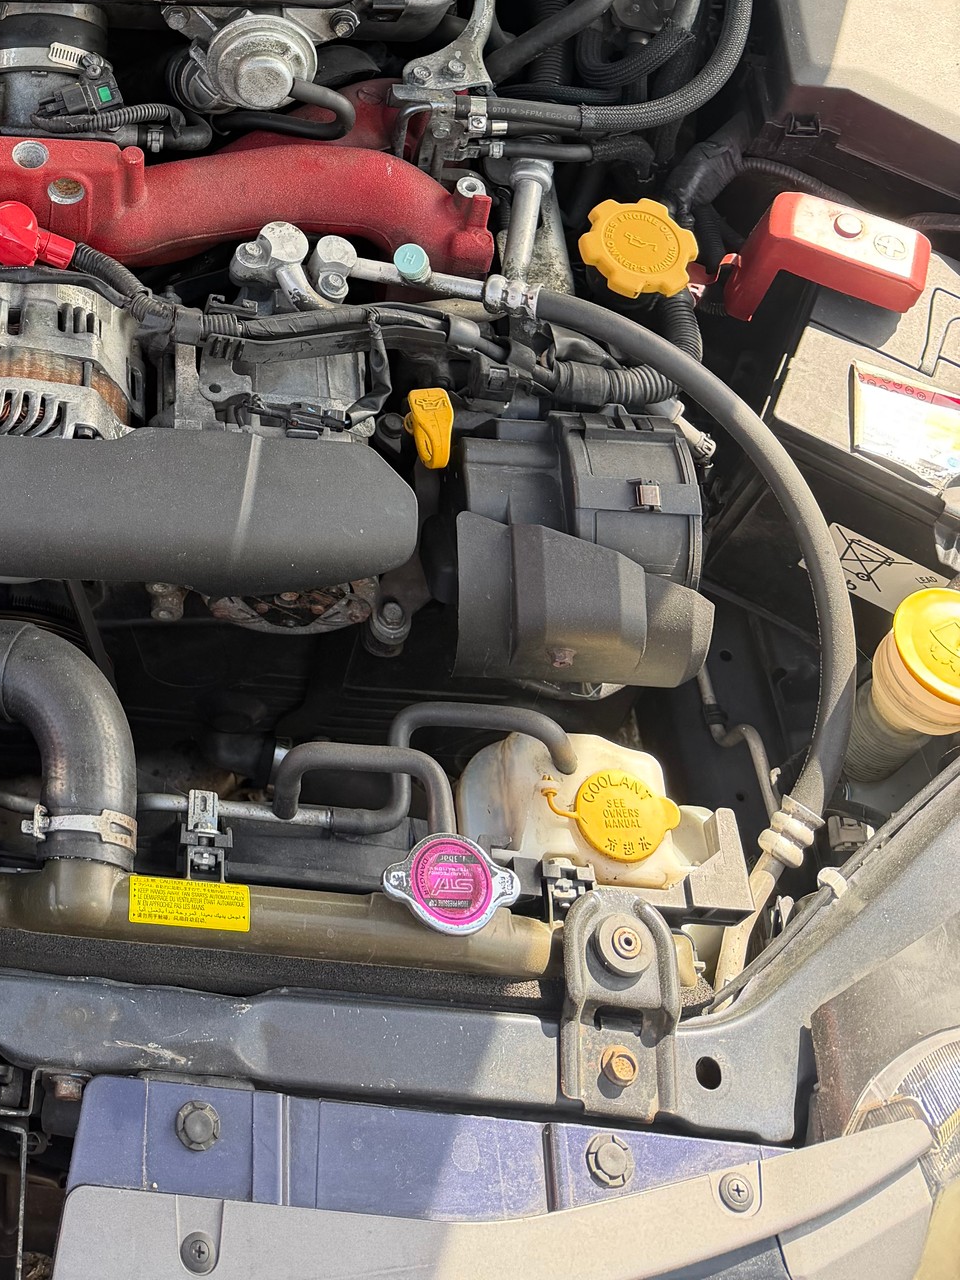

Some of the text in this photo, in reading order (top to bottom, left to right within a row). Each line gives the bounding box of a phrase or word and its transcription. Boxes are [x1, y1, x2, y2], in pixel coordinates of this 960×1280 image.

[604, 222, 616, 240] SEE
[617, 212, 674, 241] ENGINE OIL
[404, 252, 416, 264] H
[606, 241, 646, 273] OWNER'S
[914, 576, 938, 584] LEAD
[582, 774, 652, 802] COOLANT
[606, 799, 626, 808] SEE
[602, 809, 640, 818] OWNERS
[604, 819, 642, 829] MANUAL
[420, 858, 429, 895] DANGER
